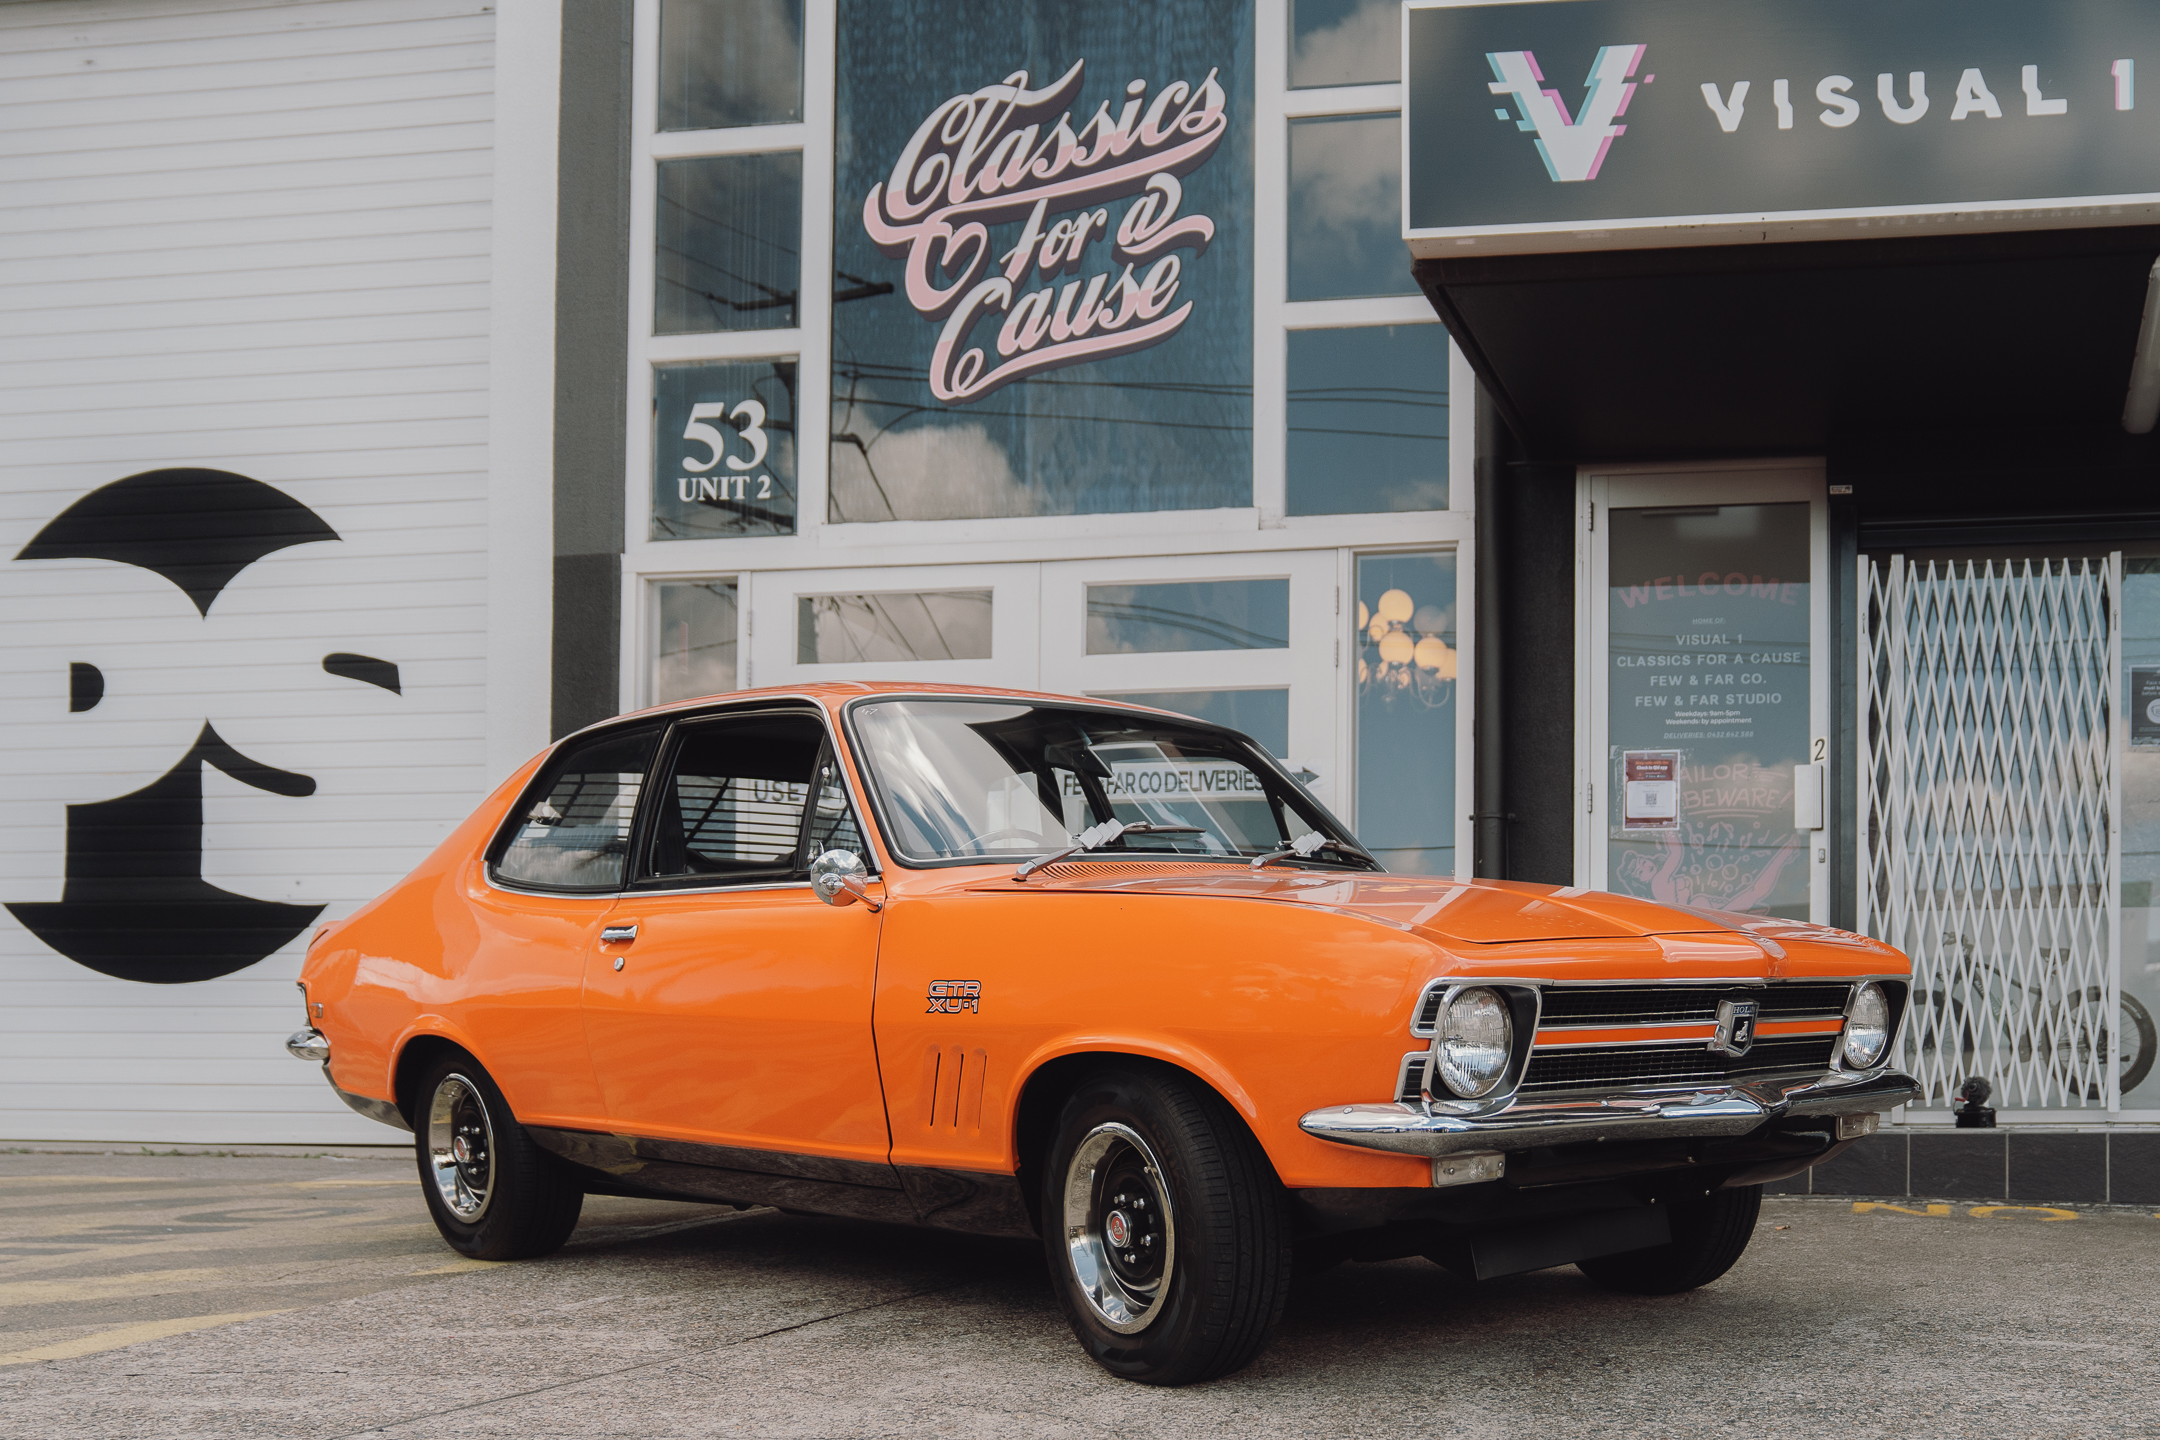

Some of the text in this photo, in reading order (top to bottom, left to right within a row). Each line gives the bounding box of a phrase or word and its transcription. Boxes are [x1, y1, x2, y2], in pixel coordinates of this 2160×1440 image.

[1701, 58, 2136, 132] VISUAL 1
[864, 58, 1228, 245] Classics
[1000, 172, 1214, 282] for a
[928, 254, 1193, 401] Cause
[681, 398, 768, 472] 53
[677, 474, 772, 502] UNIT 2
[1617, 571, 1802, 609] WELCOME
[1692, 617, 1714, 625] HOME
[1676, 633, 1743, 646] VISUAL 1
[1616, 651, 1801, 667] CLASSICS FOR A CAUSE
[1650, 673, 1767, 686] FEW & FAR CO.
[1635, 692, 1782, 707] FEW & FAR STUDIO
[1674, 710, 1708, 718] Weekdays:
[1710, 717, 1752, 725] appointment
[1663, 731, 1706, 739] DELIVERIES:
[1814, 738, 1825, 761] 2
[1106, 771, 1136, 794] FAR
[1139, 771, 1163, 794] CO
[1165, 769, 1264, 793] DELIVERIES
[1680, 763, 1751, 784] AILOR
[754, 780, 800, 801] USE
[1683, 787, 1794, 809] BEWARE!
[928, 980, 982, 998] GTR
